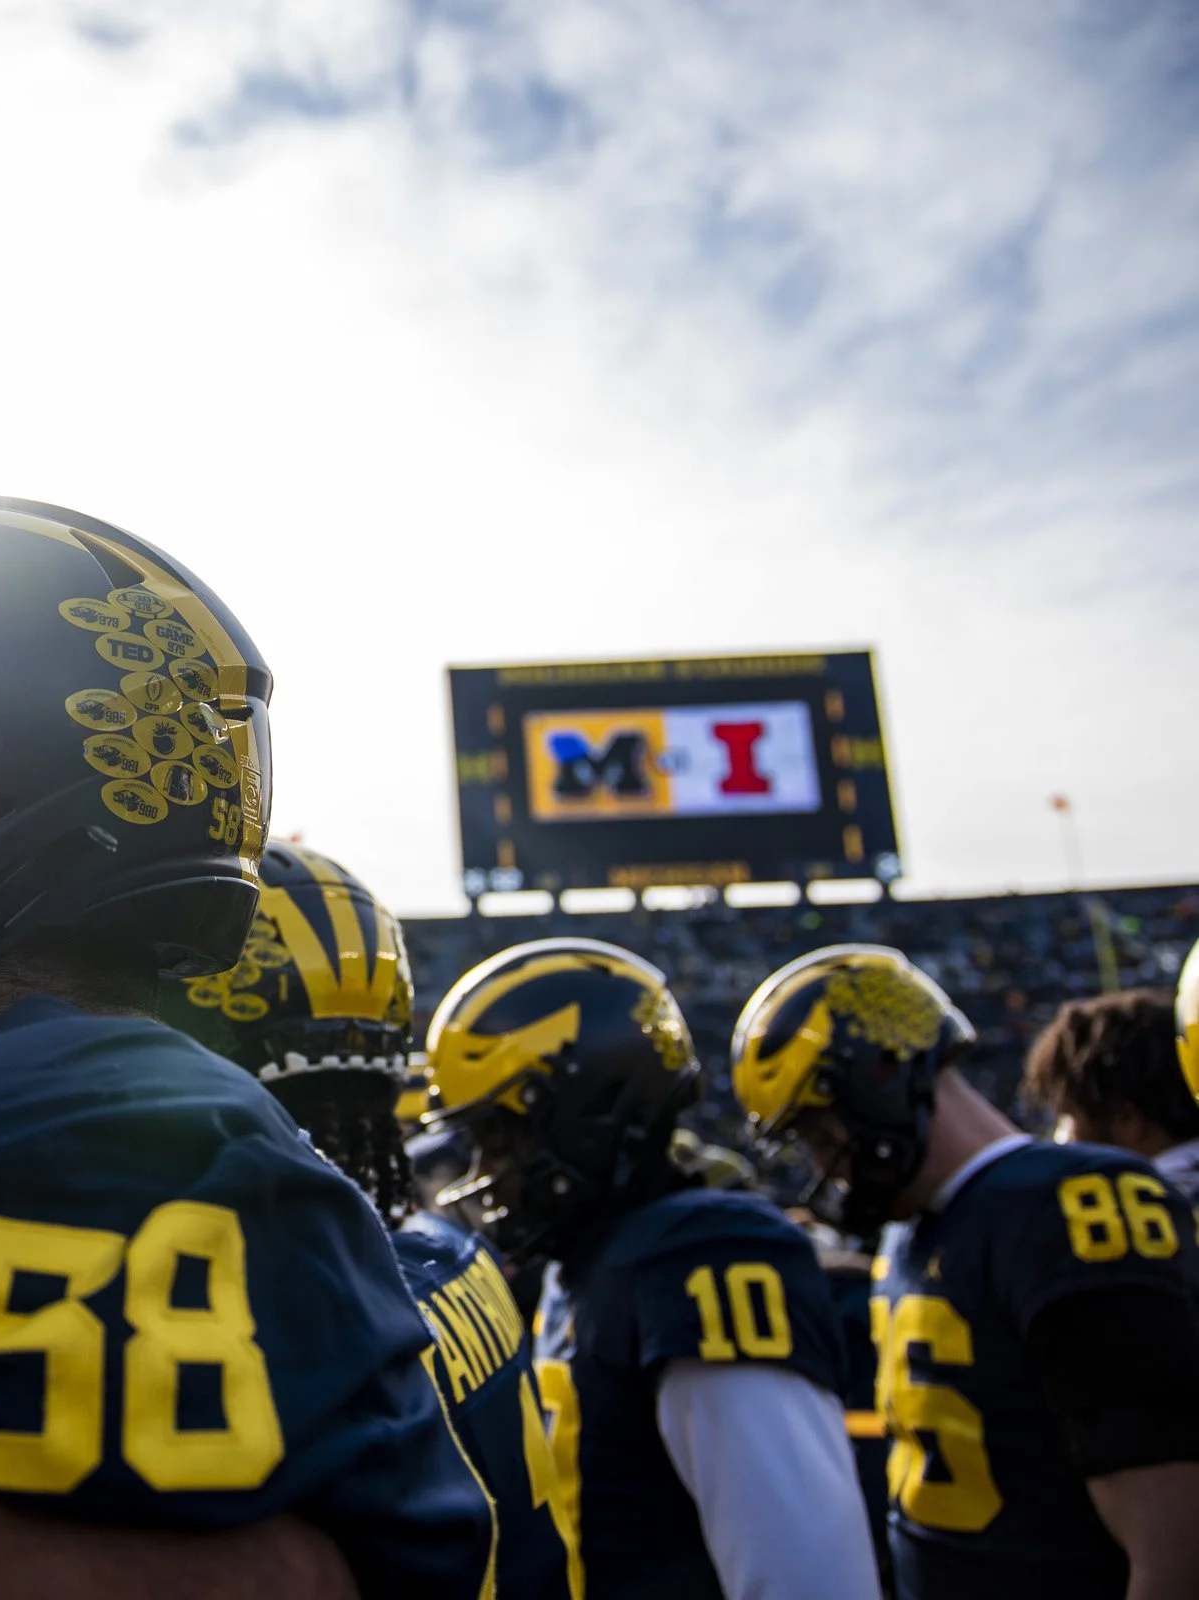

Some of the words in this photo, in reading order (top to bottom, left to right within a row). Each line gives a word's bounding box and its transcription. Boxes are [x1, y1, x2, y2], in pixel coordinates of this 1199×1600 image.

[156, 625, 194, 647] GAME
[167, 640, 185, 656] 975
[107, 639, 154, 663] TED
[144, 702, 159, 712] CFP
[712, 719, 772, 795] I
[138, 803, 158, 819] 980
[209, 796, 241, 846] 58
[1057, 1172, 1179, 1263] 86
[685, 1261, 794, 1362] 10
